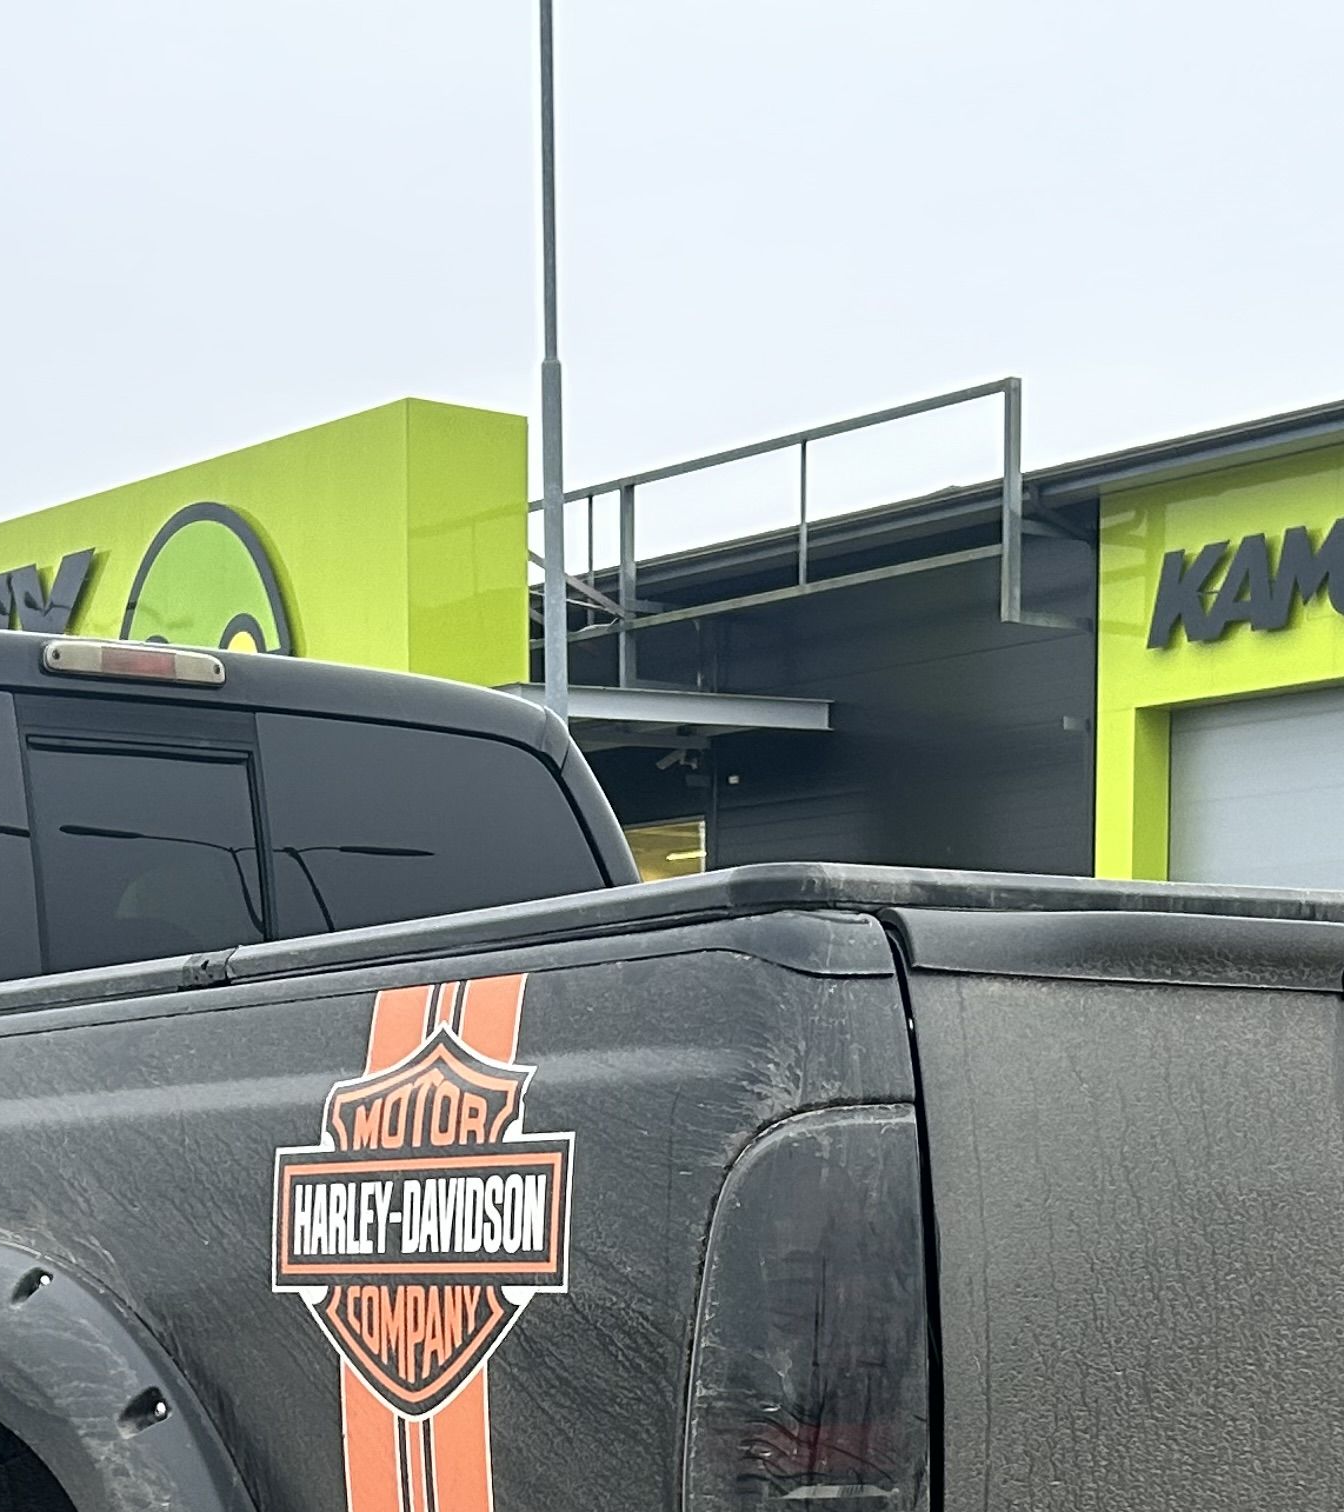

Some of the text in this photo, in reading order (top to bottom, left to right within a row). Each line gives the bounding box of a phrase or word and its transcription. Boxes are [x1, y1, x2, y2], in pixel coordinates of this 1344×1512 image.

[353, 1068, 487, 1150] MOTOR
[293, 1174, 547, 1256] HARLEY-DAVIDSON
[347, 1285, 481, 1383] COMPANY
